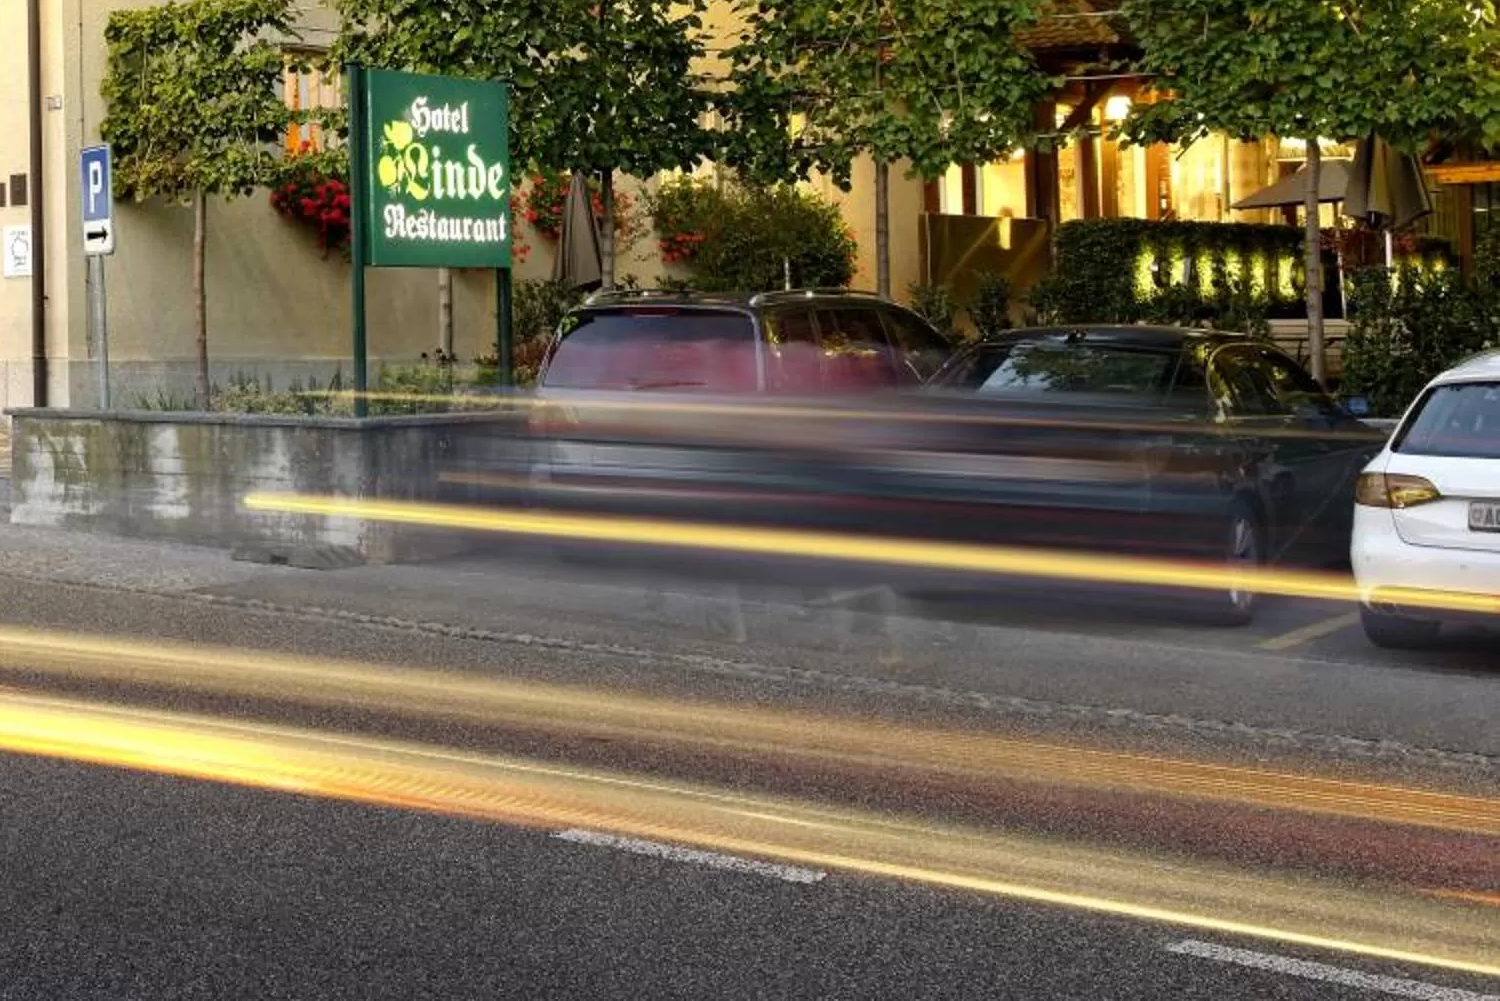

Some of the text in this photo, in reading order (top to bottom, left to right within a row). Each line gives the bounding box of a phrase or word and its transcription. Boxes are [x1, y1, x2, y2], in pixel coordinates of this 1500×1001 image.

[409, 96, 469, 137] Hotel
[88, 160, 103, 215] P
[402, 142, 506, 200] Linde
[383, 202, 507, 243] Restaurant
